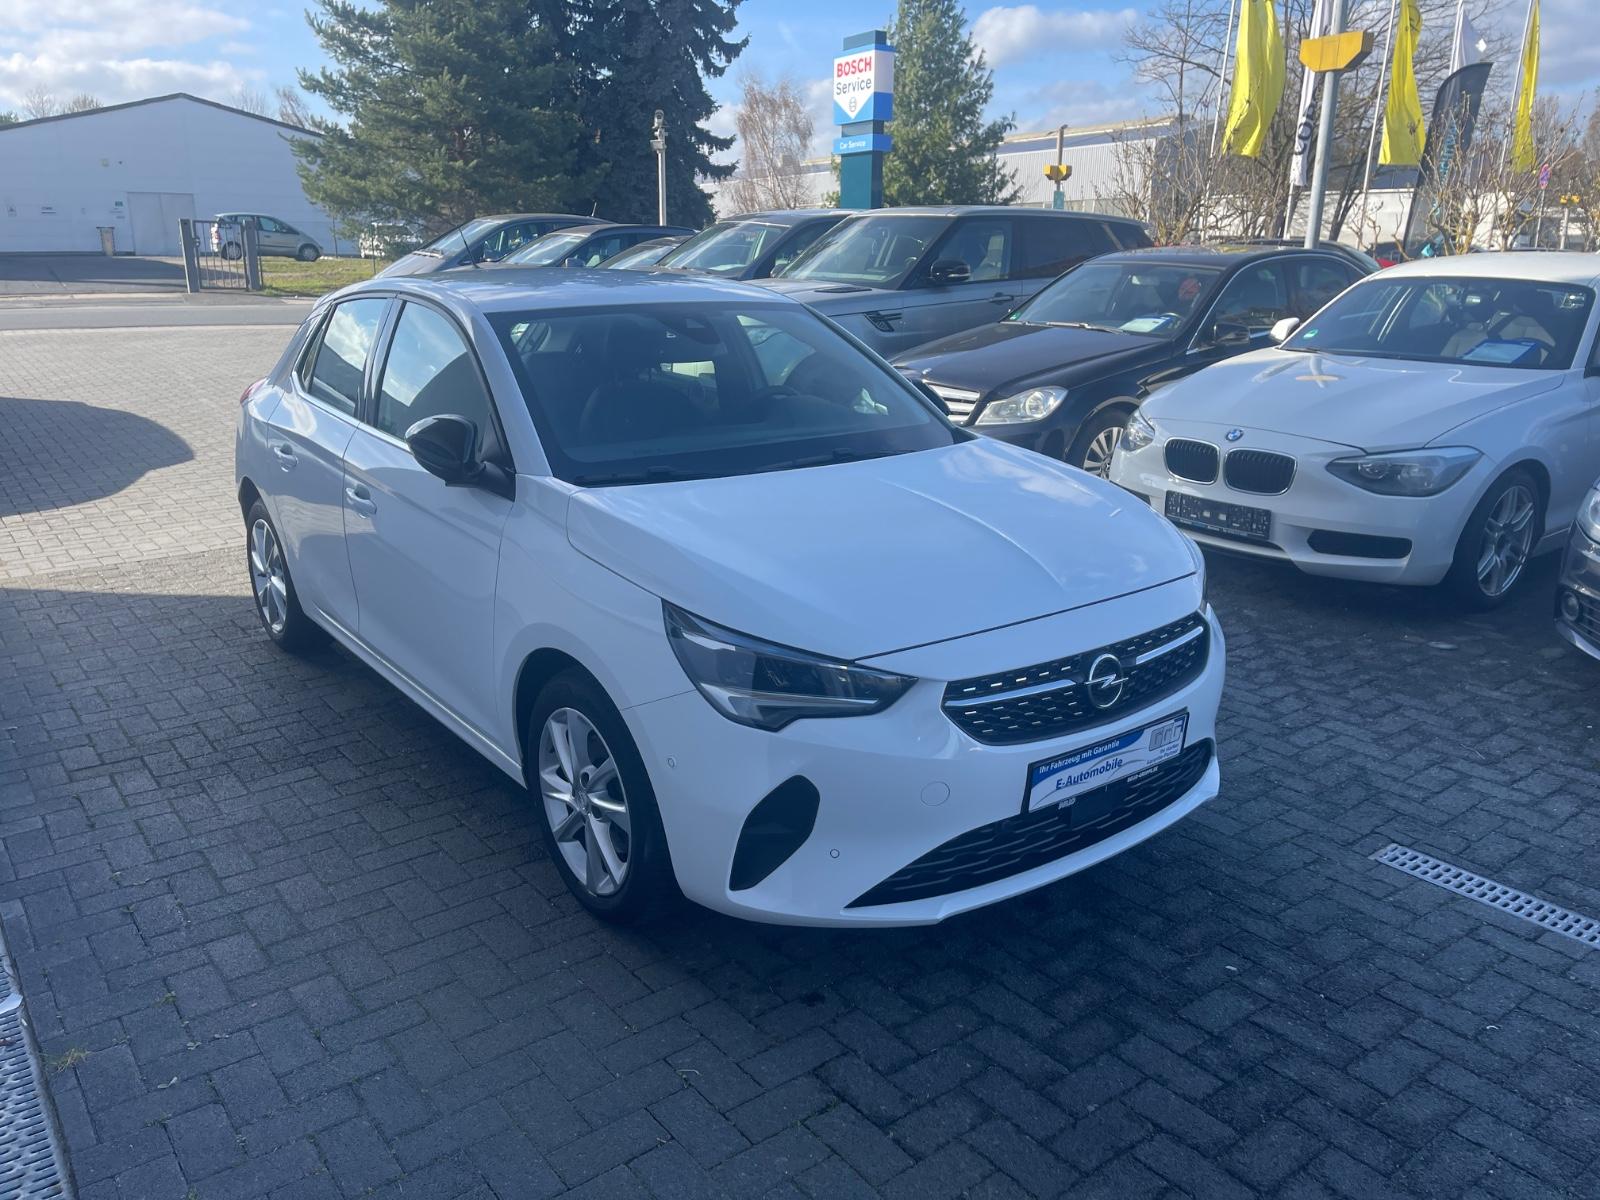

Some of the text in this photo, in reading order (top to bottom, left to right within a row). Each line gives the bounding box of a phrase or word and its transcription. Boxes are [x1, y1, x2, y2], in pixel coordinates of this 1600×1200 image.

[836, 56, 872, 78] BOSCH
[836, 77, 872, 96] Service
[1039, 739, 1120, 774] Ihr Fahrzeug mit Garantie
[1056, 757, 1123, 791] E-Automobile
